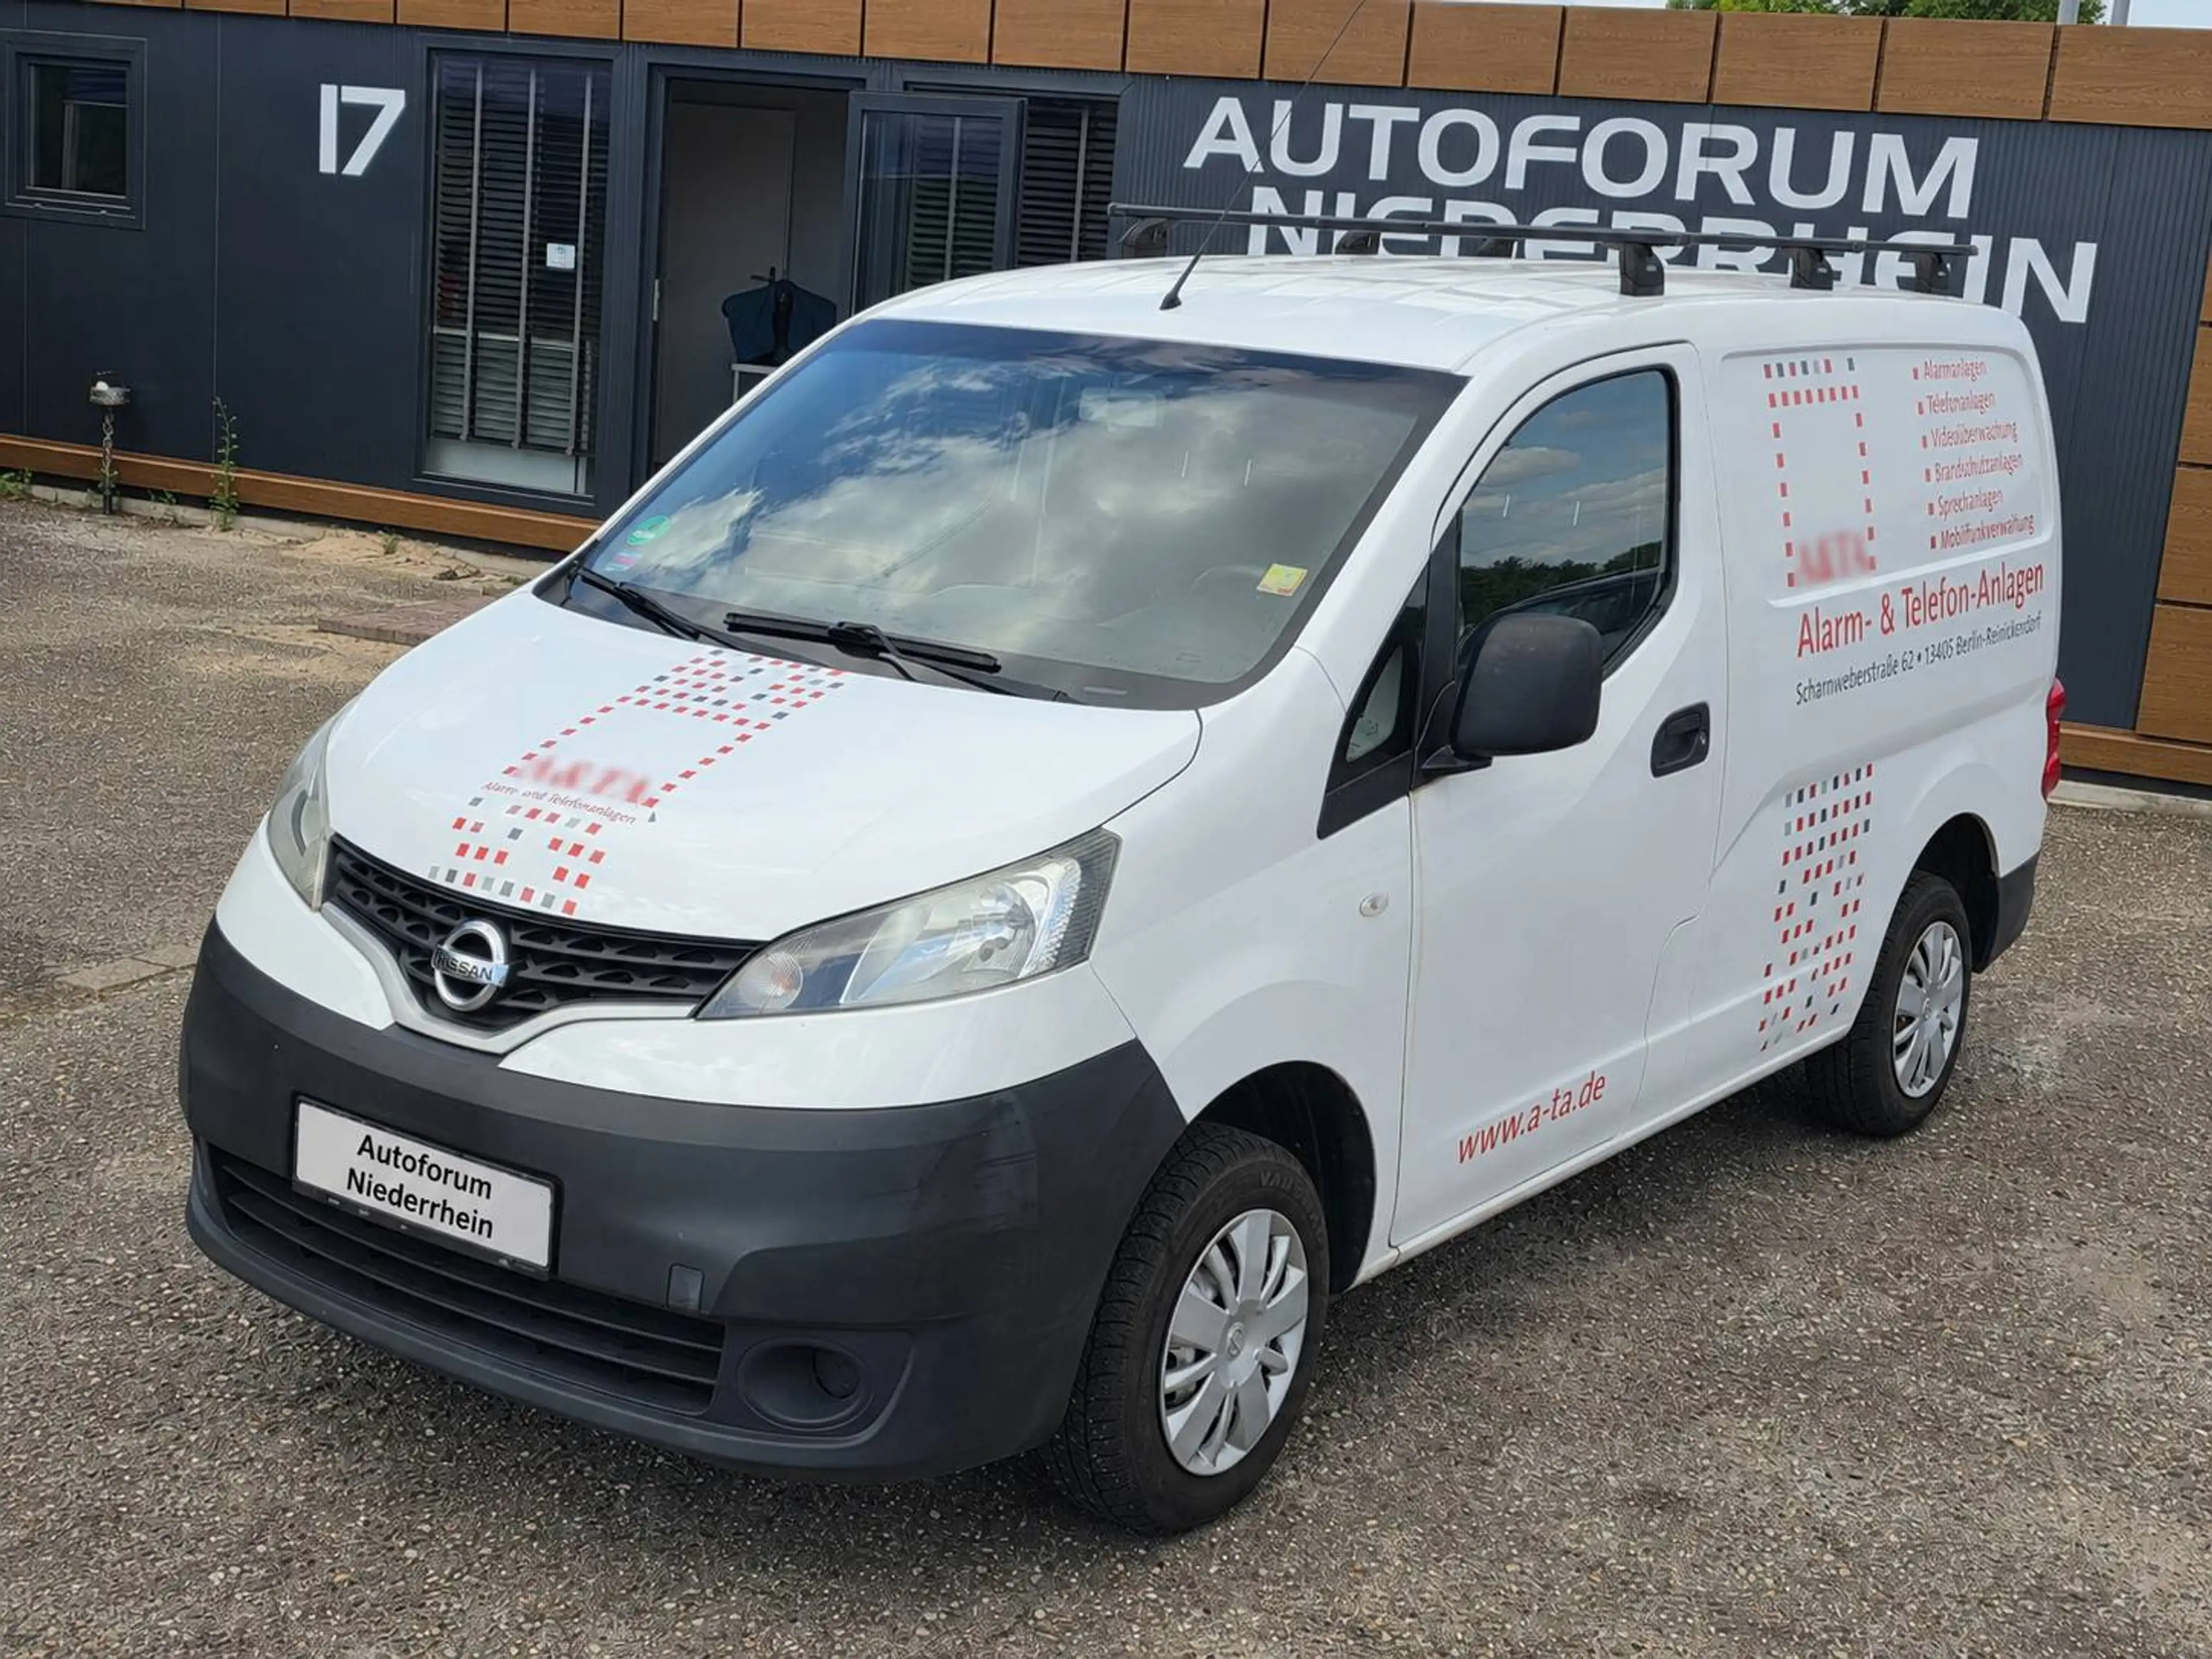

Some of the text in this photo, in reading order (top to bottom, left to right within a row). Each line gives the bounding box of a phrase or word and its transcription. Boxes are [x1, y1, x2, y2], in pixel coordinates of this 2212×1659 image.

[319, 83, 406, 176] 17
[1183, 97, 1979, 218] AUTOFORUM
[1926, 391, 1995, 415] Telefonanlagen
[1938, 489, 2003, 521] Sprechanlagen
[1797, 562, 2044, 658] Alarm- & Telefon-Anlagen
[1796, 654, 1898, 706] Scharnweberstraße
[1902, 650, 1914, 672] 62
[1459, 1070, 1605, 1164] www.a-ta.de
[357, 1134, 491, 1200] Autoforum
[346, 1168, 493, 1238] Niederrhein
